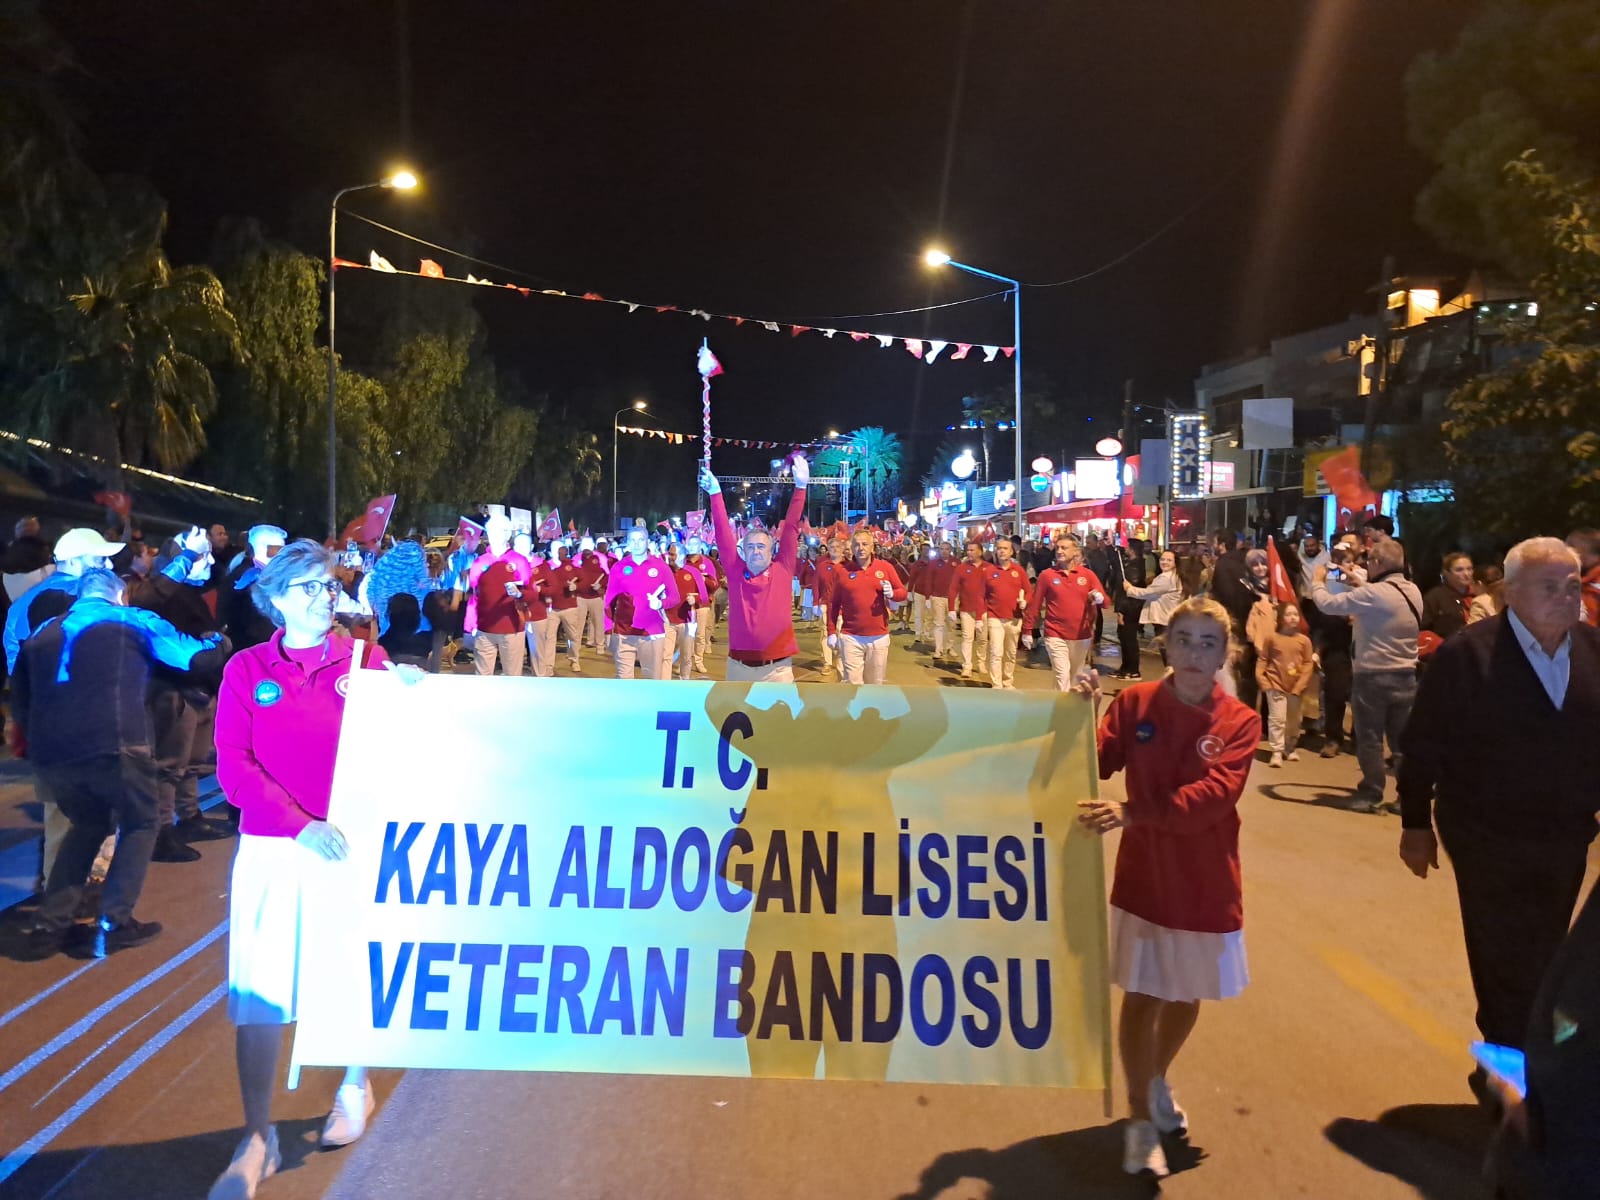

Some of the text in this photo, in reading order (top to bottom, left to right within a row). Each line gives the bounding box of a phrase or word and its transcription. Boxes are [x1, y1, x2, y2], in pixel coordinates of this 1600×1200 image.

[1181, 420, 1197, 483] TAXI
[655, 711, 768, 791] T. C.
[375, 807, 1048, 922] KAYA ALDOĞAN LİSESİ
[368, 941, 1053, 1050] VETERAN BANDOSU
